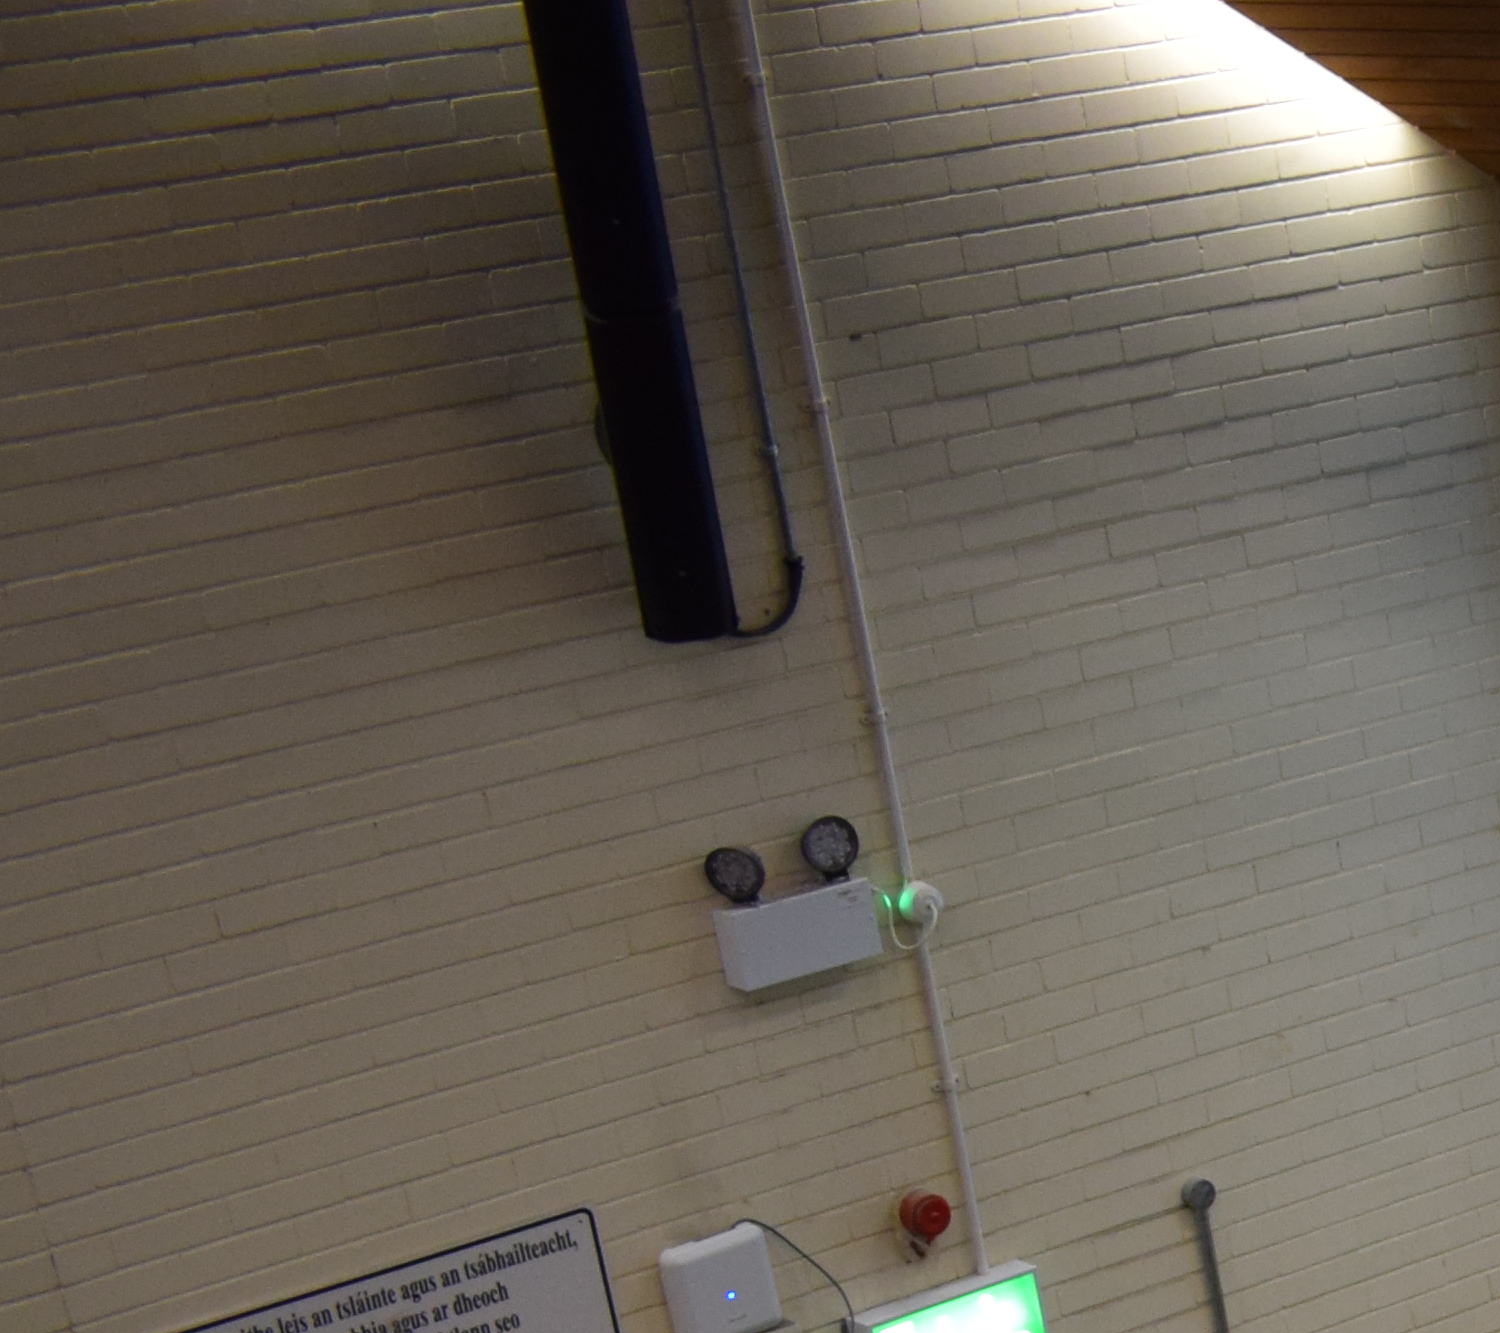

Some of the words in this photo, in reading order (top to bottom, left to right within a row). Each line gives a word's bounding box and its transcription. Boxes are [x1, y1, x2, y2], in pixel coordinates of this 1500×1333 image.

[310, 1307, 334, 1329] an
[334, 1286, 397, 1321] tsláinte
[399, 1275, 438, 1304] agus
[439, 1267, 462, 1288] an
[462, 1228, 578, 1280] tsábhailteacht,
[430, 1303, 448, 1323] ar
[451, 1280, 510, 1316] dheoch
